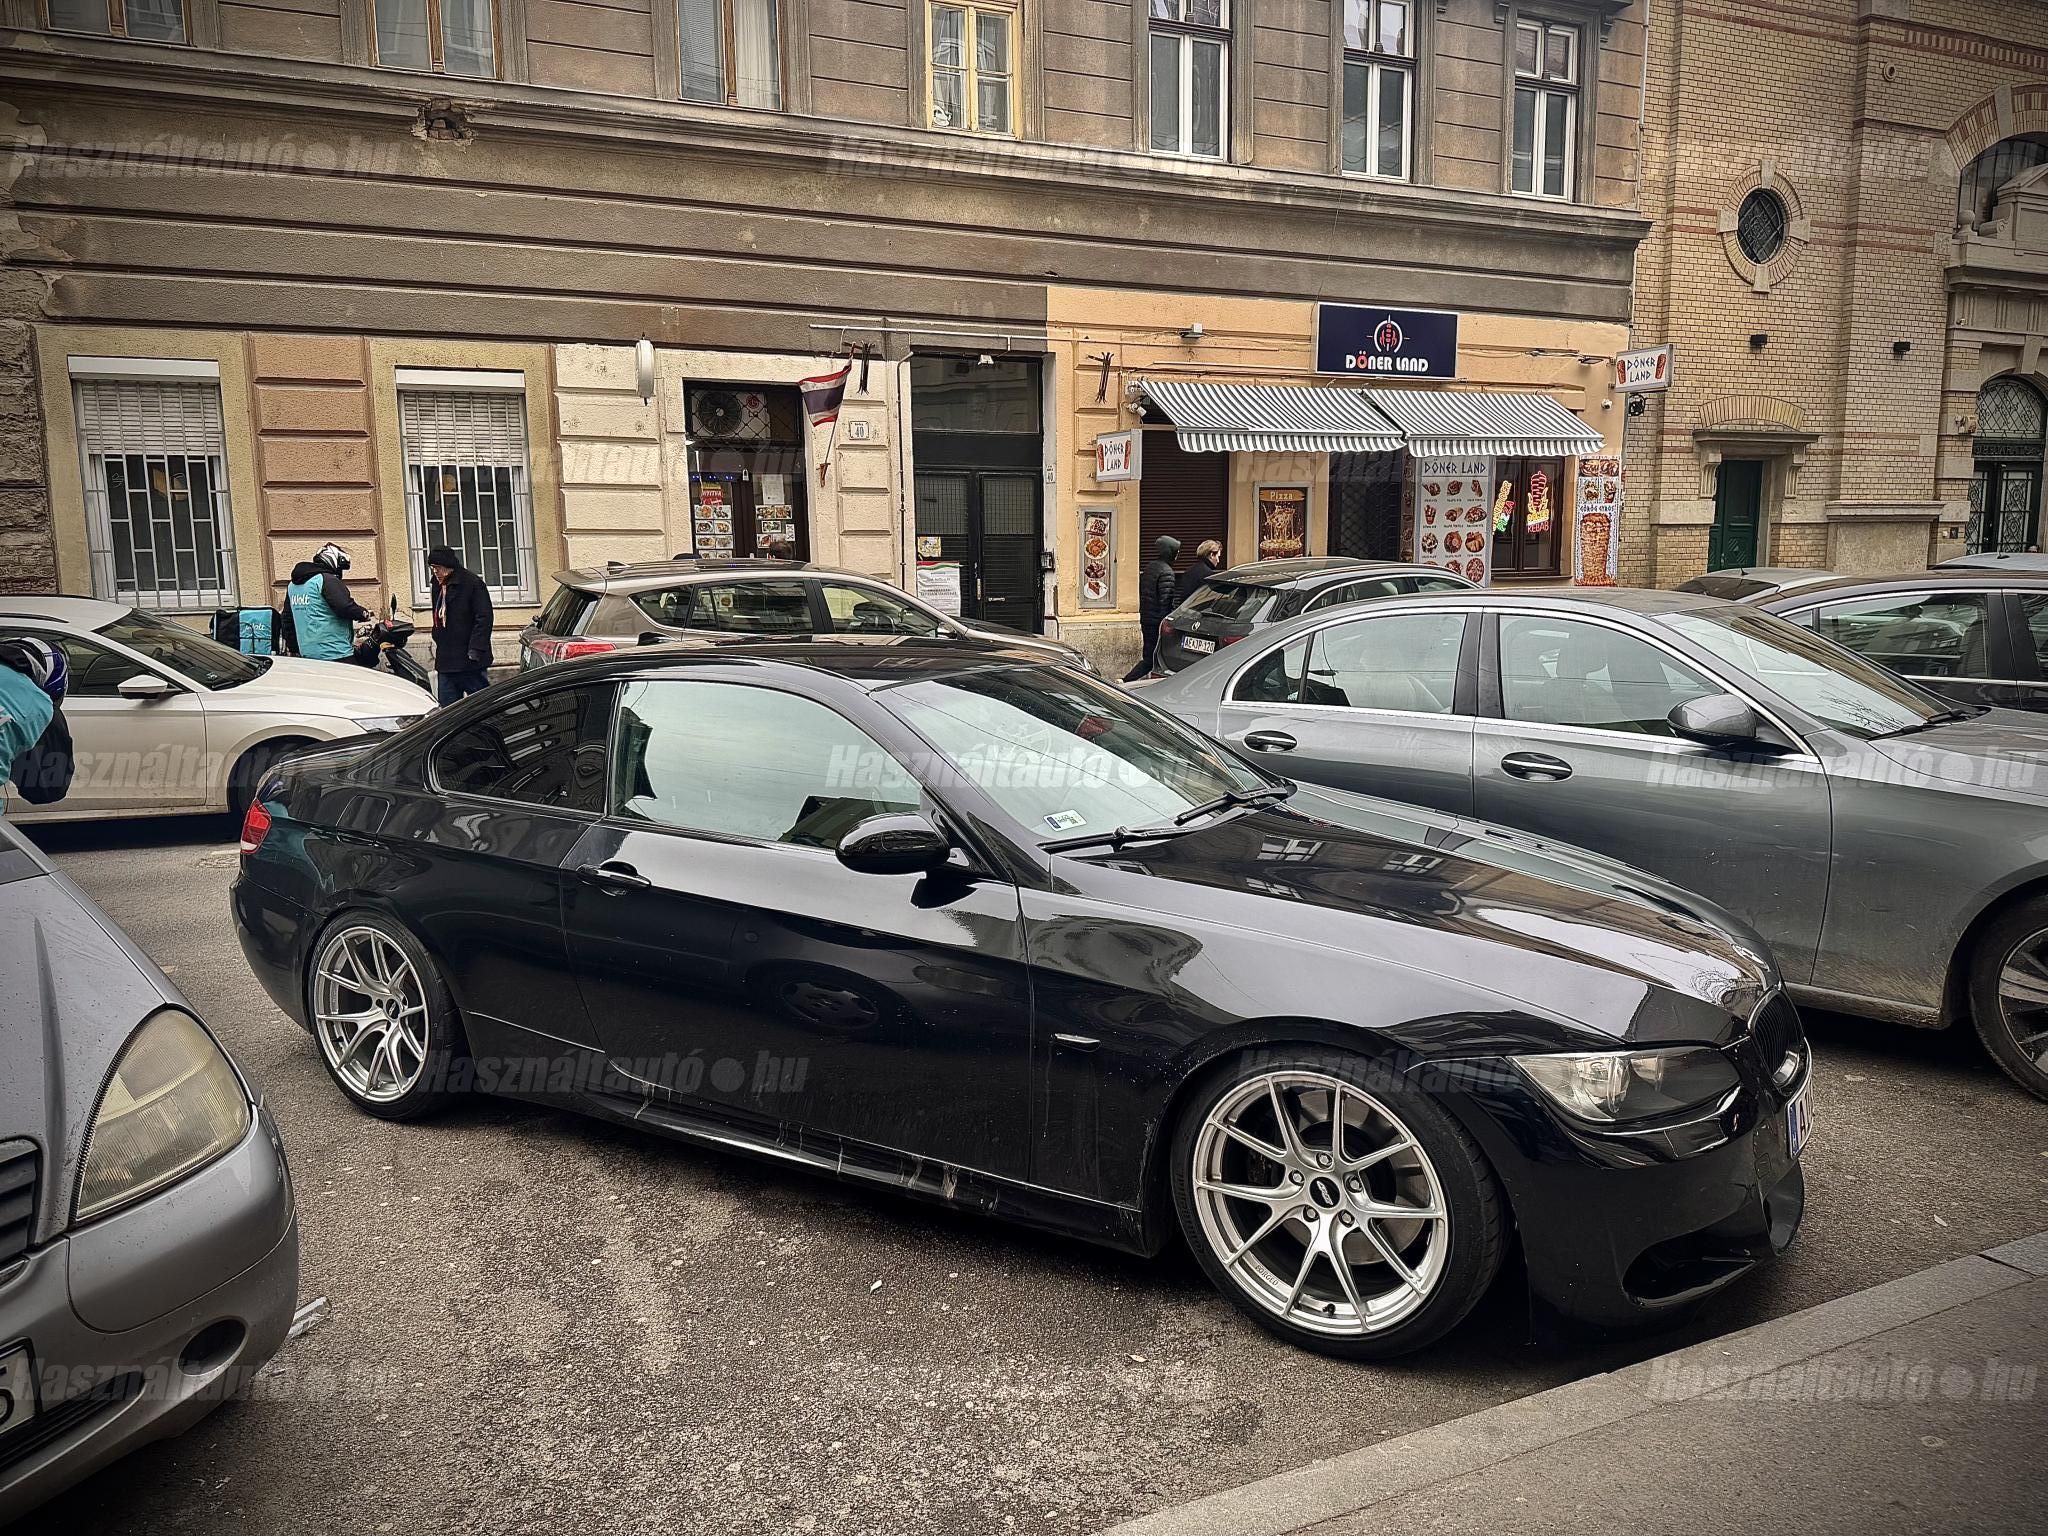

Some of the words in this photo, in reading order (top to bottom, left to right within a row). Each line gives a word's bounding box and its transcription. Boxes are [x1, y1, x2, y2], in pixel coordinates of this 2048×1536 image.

[1345, 350, 1393, 371] DÖNER
[1396, 357, 1429, 372] LAND
[1627, 356, 1656, 371] DÖNER
[1630, 370, 1651, 382] LAND
[1104, 440, 1125, 456] DÖNER
[1106, 458, 1122, 471] LAND
[1424, 458, 1458, 474] DÖNER
[1461, 462, 1486, 474] LAND
[1270, 491, 1293, 500] Pizza
[1528, 521, 1549, 533] KEBAB
[292, 593, 309, 605] Wolt
